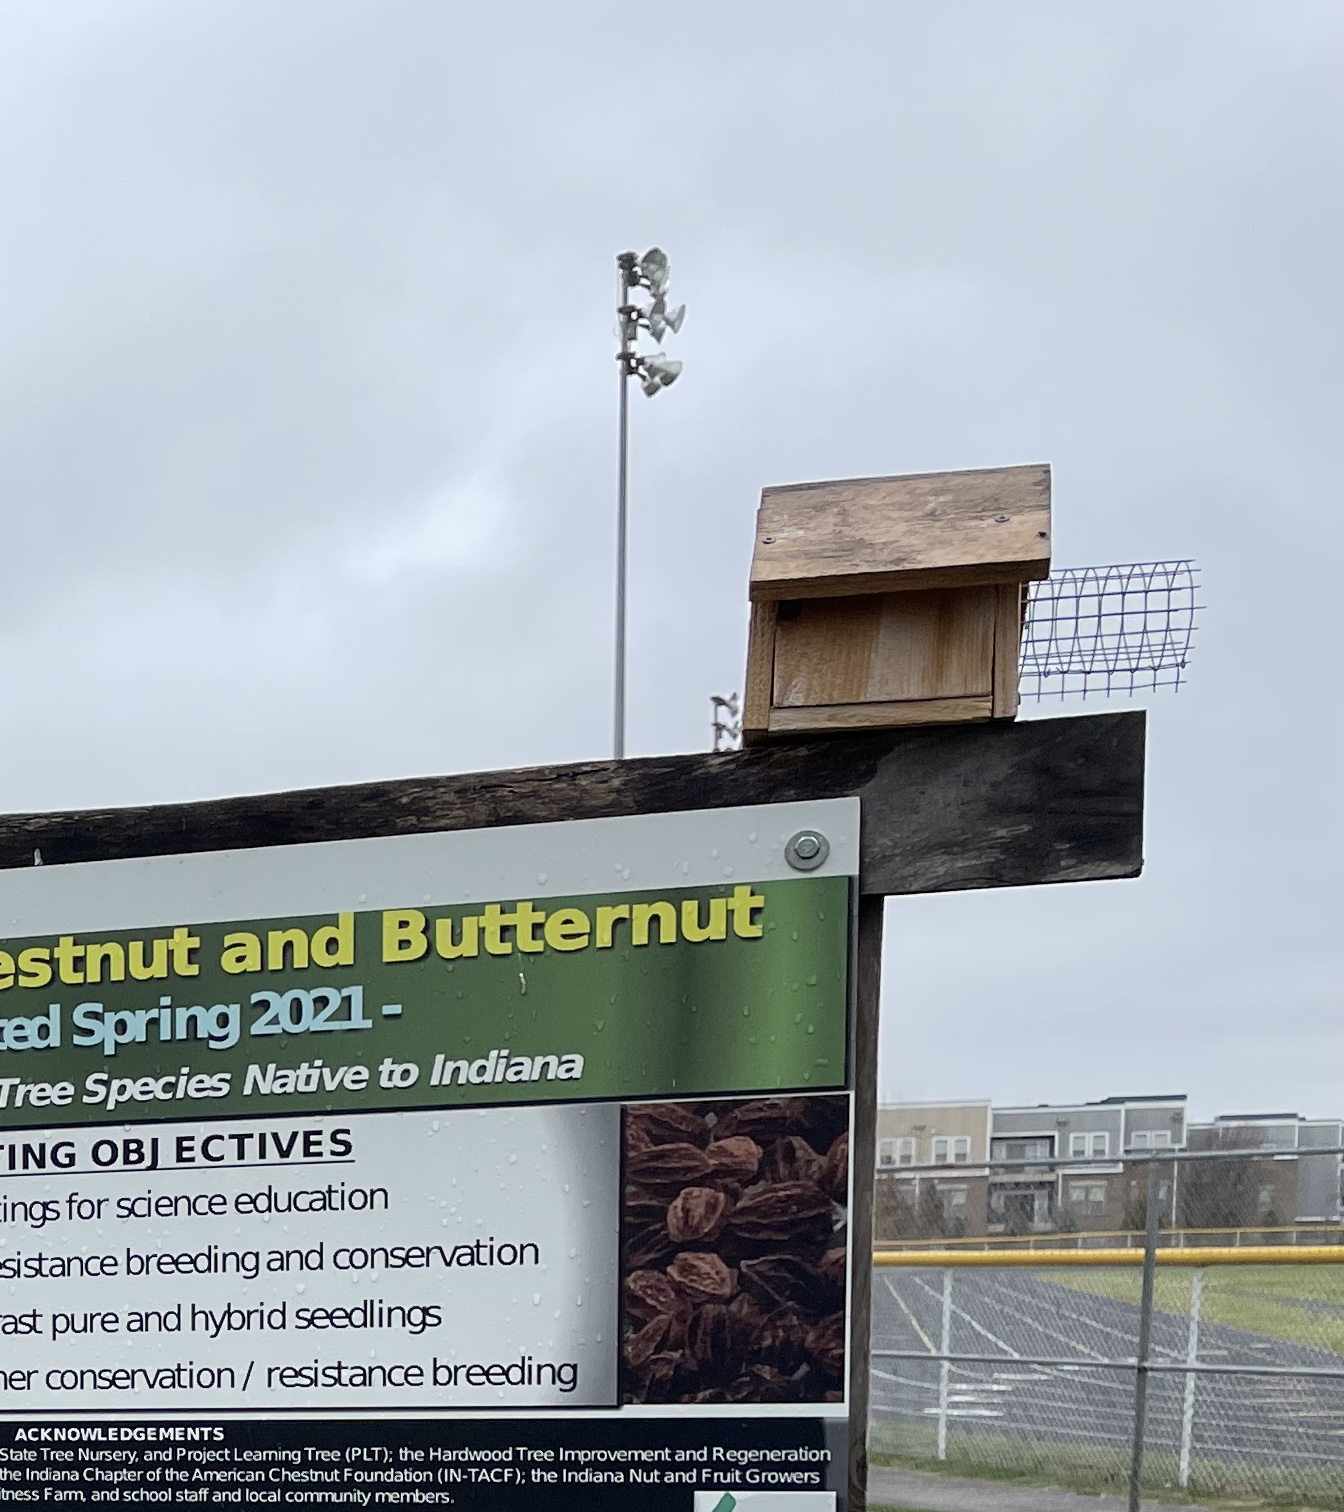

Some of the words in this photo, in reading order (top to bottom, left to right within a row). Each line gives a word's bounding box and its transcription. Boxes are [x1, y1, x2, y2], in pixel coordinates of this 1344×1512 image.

[220, 911, 355, 974] and
[381, 885, 765, 963] Butternut
[72, 997, 241, 1056] Spring
[249, 984, 373, 1037] 2021
[381, 1002, 403, 1016] -
[82, 1066, 232, 1109] Species
[242, 1060, 369, 1096] Native
[378, 1057, 419, 1089] to
[430, 1049, 585, 1087] Indiana
[65, 1191, 110, 1222] for
[115, 1186, 227, 1219] science
[233, 1181, 390, 1216] education
[126, 1243, 260, 1280] breeding
[265, 1241, 325, 1272] and
[332, 1235, 541, 1270] conservation
[51, 1311, 119, 1341] pure
[126, 1304, 181, 1333] and
[189, 1299, 287, 1339] hybrid
[293, 1298, 442, 1334] seedlings
[44, 1360, 236, 1391] conservation
[241, 1359, 255, 1391] /
[266, 1358, 424, 1390] resistance
[432, 1355, 579, 1393] breeding
[14, 1427, 225, 1442] ACKNOWLEDGEMENTS
[0, 1467, 22, 1482] the
[25, 1467, 80, 1482] Indiana
[82, 1467, 145, 1484] Chapter
[146, 1467, 162, 1482] of
[164, 1467, 189, 1482] the
[191, 1467, 266, 1482] American
[268, 1467, 341, 1483] Chestnut
[343, 1467, 434, 1483] Foundation
[530, 1468, 558, 1483] the
[562, 1468, 625, 1483] Indiana
[629, 1468, 661, 1483] Nut
[663, 1468, 697, 1484] and
[701, 1468, 743, 1484] Fruit
[745, 1468, 821, 1484] Growers
[40, 1448, 74, 1462] Tree
[143, 1447, 173, 1462] and
[176, 1447, 231, 1464] Project
[233, 1446, 302, 1465] Learning
[304, 1447, 341, 1462] Tree
[399, 1447, 425, 1462] the
[429, 1446, 513, 1462] Hardwood
[515, 1447, 555, 1462] Tree
[559, 1446, 672, 1465] Improvement
[674, 1446, 708, 1462] and
[711, 1446, 832, 1465] Regeneration
[90, 1487, 120, 1502] and
[123, 1487, 172, 1502] school
[175, 1487, 210, 1502] staff
[211, 1487, 242, 1503] and
[245, 1488, 281, 1503] local
[284, 1488, 372, 1507] community
